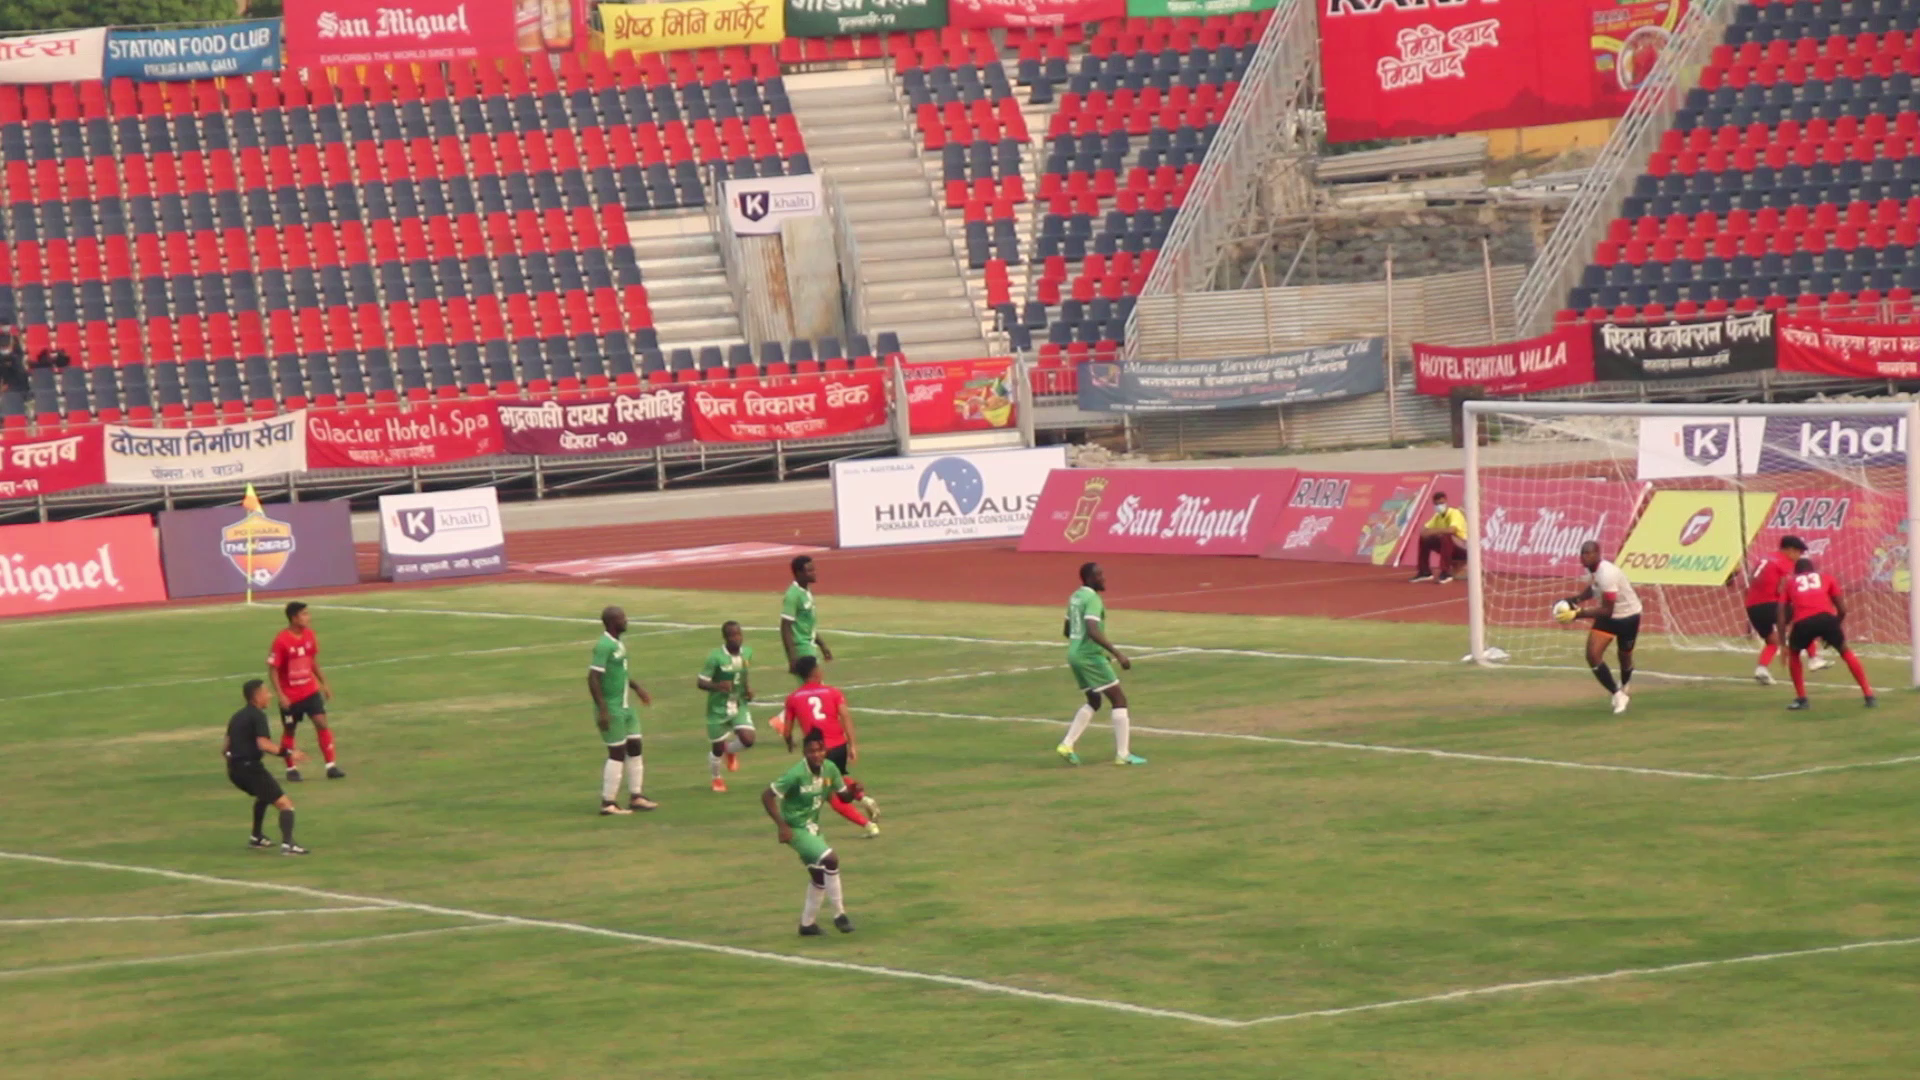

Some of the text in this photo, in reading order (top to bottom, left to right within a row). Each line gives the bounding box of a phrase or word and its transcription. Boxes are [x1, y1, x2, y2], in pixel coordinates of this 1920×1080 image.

[317, 3, 470, 39] San Miguel
[661, 8, 709, 36] मिनि
[714, 0, 769, 38] मार्केट
[108, 28, 270, 58] STATION FOOD CLUB
[373, 51, 391, 60] THE
[392, 49, 427, 59] WORLD
[746, 194, 809, 215] K khalti
[1420, 341, 1567, 379] HOTEL FISHTAIL VILLA
[498, 401, 563, 433] भद्रकाली
[566, 403, 610, 426] टायर
[743, 391, 817, 416] विकास
[109, 420, 294, 456] दोलखा निर्माण सेवा
[309, 409, 489, 442] Glacier Hotel & Spa
[1694, 418, 1907, 457] K khal
[10, 435, 84, 468] क्लब
[1289, 478, 1350, 509] RARA
[406, 511, 483, 534] K khalti
[875, 500, 956, 521] HIMA
[876, 521, 920, 531] POKHARA
[923, 517, 975, 528] EDUCATION
[1109, 494, 1163, 536] San
[1160, 493, 1261, 546] Miguel
[1767, 497, 1850, 530] RARA
[1481, 506, 1525, 554] San
[1620, 553, 1729, 571] FOODMANDU
[1795, 572, 1822, 592] 33
[808, 696, 827, 720] 2
